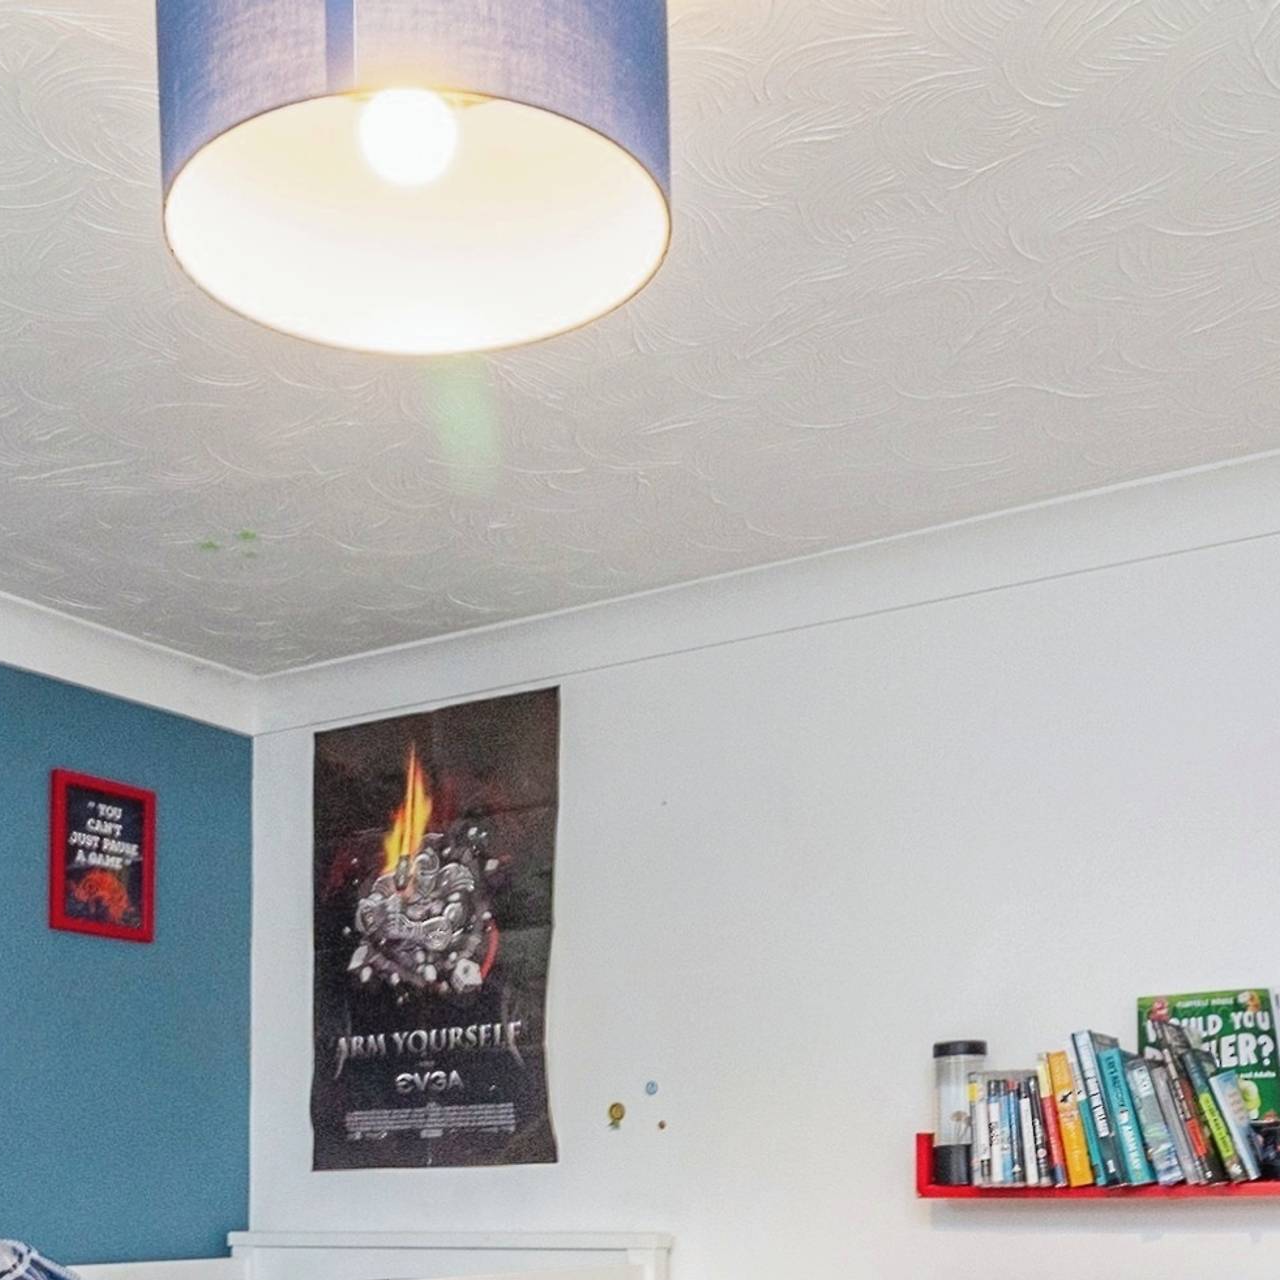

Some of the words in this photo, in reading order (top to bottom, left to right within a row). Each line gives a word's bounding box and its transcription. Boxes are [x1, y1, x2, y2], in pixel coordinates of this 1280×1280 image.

[98, 803, 122, 820] YOU
[68, 831, 100, 849] JUST
[75, 849, 86, 866] A
[88, 851, 122, 870] GAME
[1230, 1010, 1270, 1031] YOU
[392, 1021, 523, 1062] YOURSELF
